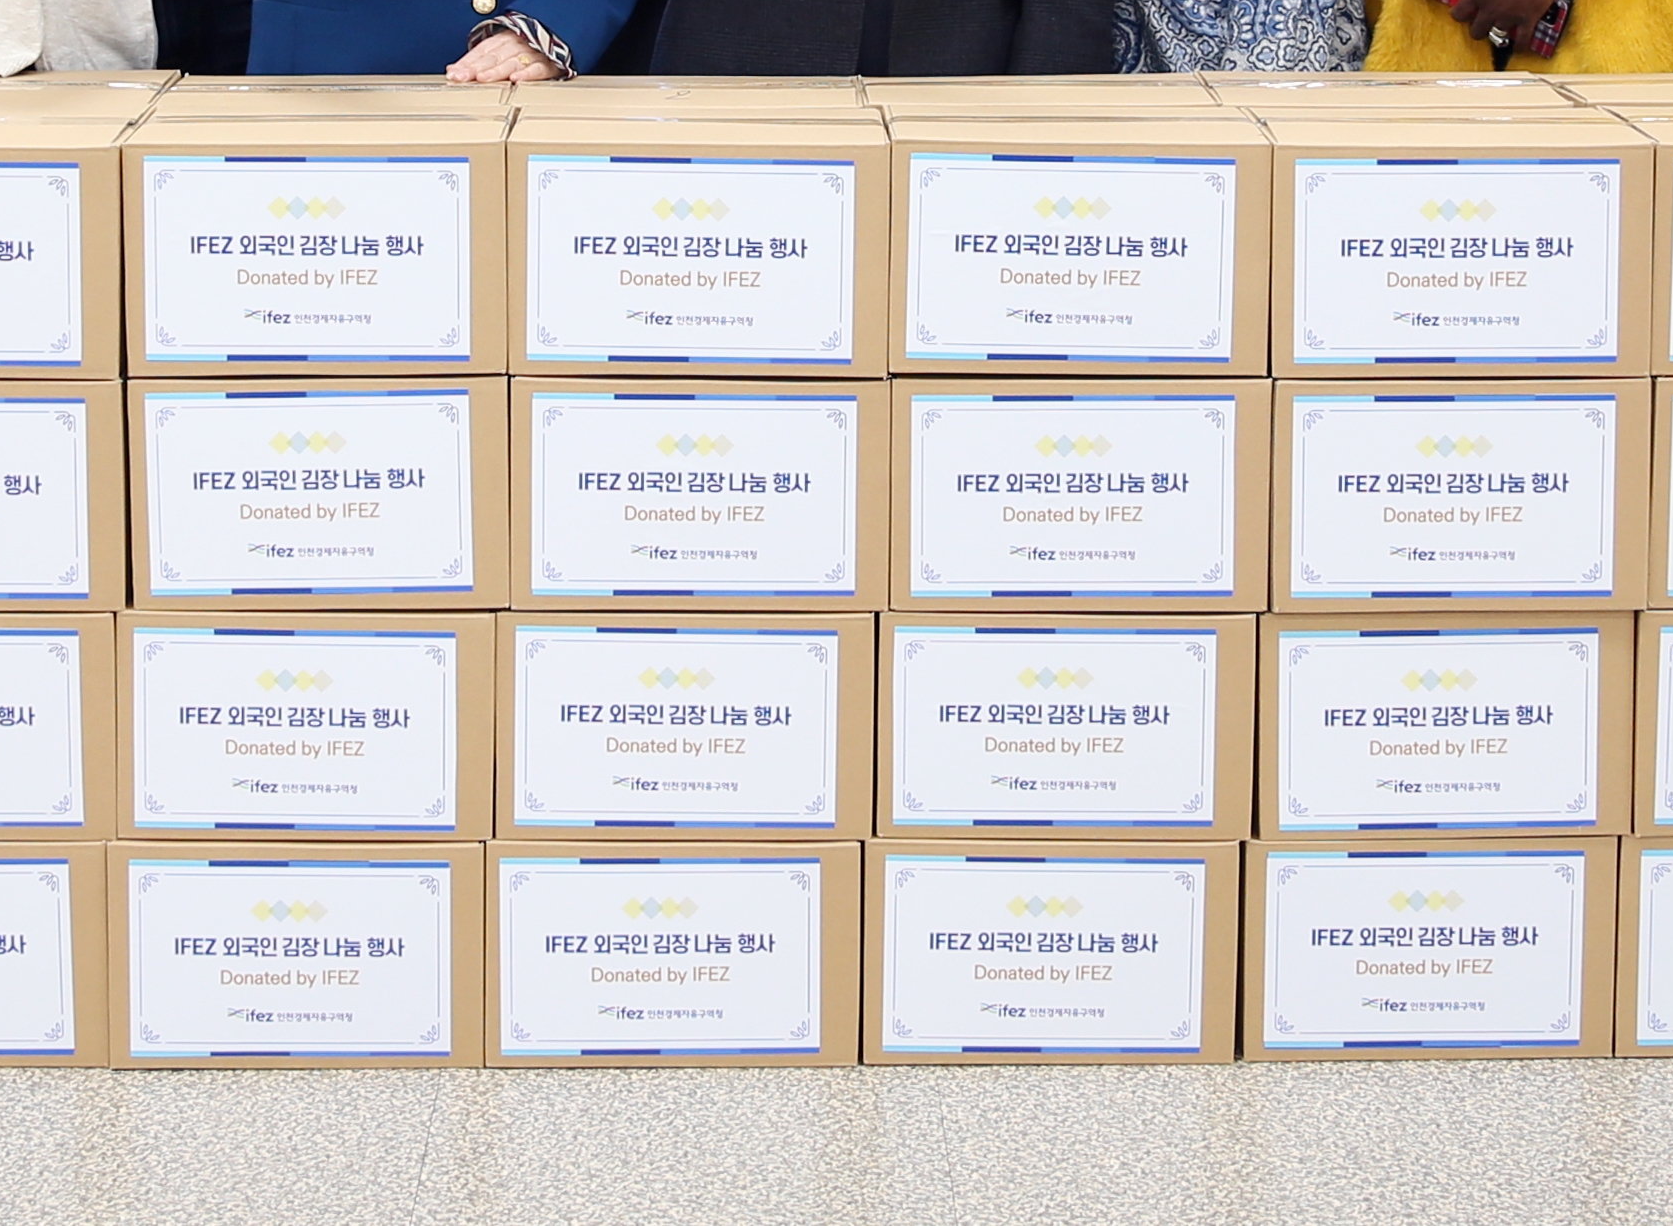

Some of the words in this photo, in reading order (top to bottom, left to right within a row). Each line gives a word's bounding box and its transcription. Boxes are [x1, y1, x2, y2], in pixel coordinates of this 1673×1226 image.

[190, 236, 234, 254] IFEZ
[239, 234, 296, 256] 외국인
[299, 235, 338, 256] 김장
[341, 236, 380, 256] 나눔
[385, 236, 425, 256] 행사
[1340, 239, 1385, 257] IFEZ
[1389, 237, 1447, 258] 외국인
[1449, 237, 1489, 258] 김장
[1491, 238, 1531, 258] 나눔
[1535, 237, 1575, 257] 행사
[236, 269, 309, 286] Donated
[314, 269, 334, 288] by
[340, 270, 379, 286] IFEZ
[1386, 272, 1459, 288] Donated
[1463, 271, 1484, 290] by
[1489, 272, 1529, 287] IFEZ
[578, 473, 622, 491] IFEZ
[627, 471, 684, 493] 외국인
[687, 472, 726, 493] 김장
[728, 473, 768, 493] 나눔
[772, 473, 812, 493] 행사
[624, 505, 696, 522] Donated
[701, 506, 721, 525] by
[727, 506, 766, 522] IFEZ
[939, 705, 982, 723] IFEZ
[987, 704, 1044, 725] 외국인
[1047, 704, 1085, 725] 김장
[1088, 705, 1127, 725] 나눔
[1131, 705, 1171, 725] 행사
[984, 737, 1056, 753] Donated
[1060, 737, 1081, 756] by
[1086, 738, 1125, 754] IFEZ
[545, 936, 588, 953] IFEZ
[593, 934, 649, 954] 외국인
[653, 934, 691, 954] 김장
[694, 934, 732, 954] 나눔
[737, 934, 776, 953] 행사
[591, 967, 662, 983] Donated
[667, 967, 687, 985] by
[693, 967, 731, 982] IFEZ
